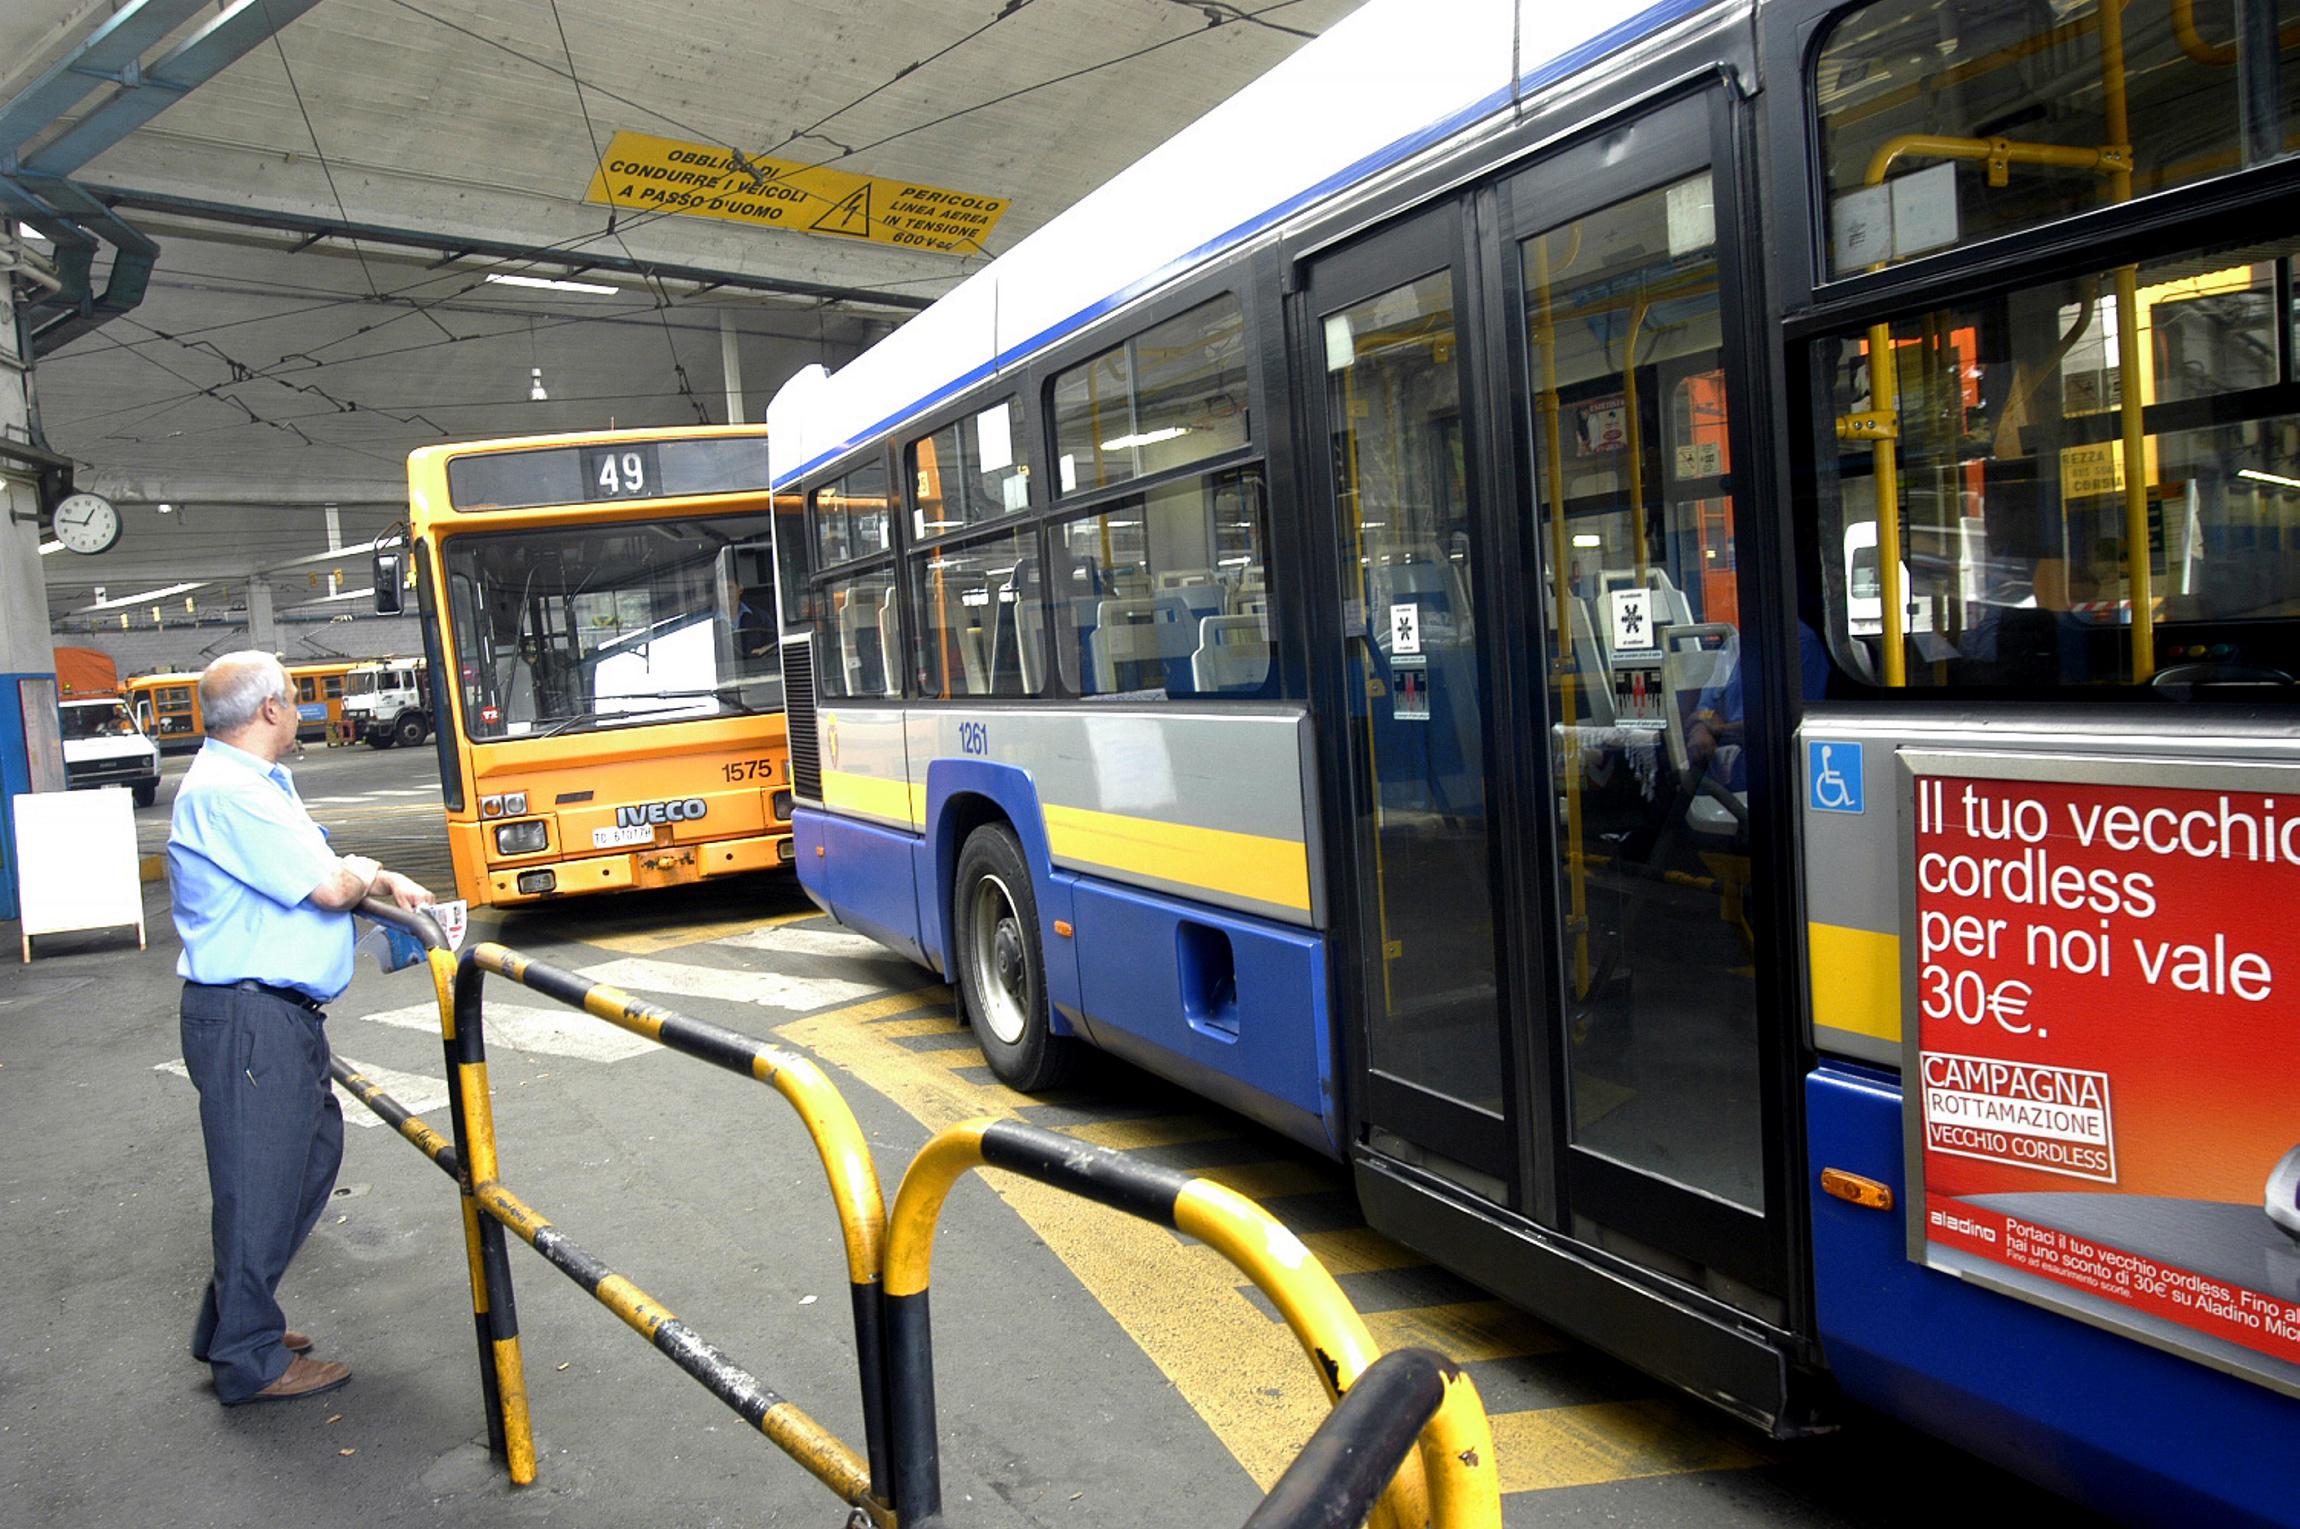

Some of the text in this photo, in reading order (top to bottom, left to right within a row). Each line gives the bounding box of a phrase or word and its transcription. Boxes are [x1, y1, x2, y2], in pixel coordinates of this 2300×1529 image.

[610, 160, 808, 203] CONDURRE I VEICOLI
[760, 166, 781, 178] DI
[618, 185, 783, 220] A PASSO D'UOMO
[889, 201, 989, 225] LINEA AEREA
[900, 187, 999, 211] PERICOLO
[882, 215, 980, 238] IN TENSIONE
[599, 452, 644, 492] 49
[959, 722, 988, 755] 1261
[722, 759, 773, 782] 1575
[616, 799, 708, 828] IVECO
[1920, 779, 1943, 834] Il
[1961, 784, 2049, 842] tuo
[1918, 848, 2156, 918] cordless
[1921, 910, 2272, 1001] per noi vale
[1921, 964, 2048, 1038] 30€.
[1924, 1056, 2104, 1109] CAMPAGNA
[1932, 1093, 2100, 1137] ROTTAMAZIONE
[1930, 1124, 2108, 1171] VECCHIO CORDLESS
[1930, 1211, 1996, 1243] aladino
[2006, 1217, 2055, 1246] Portaci
[2058, 1233, 2067, 1249] il
[2070, 1239, 2094, 1257] tuo
[2098, 1249, 2157, 1278] vecchio
[2240, 1290, 2280, 1317] Fino
[2006, 1249, 2026, 1263] Fino
[2027, 1258, 2040, 1268] ad
[2041, 1262, 2099, 1287] esaurimento
[2006, 1233, 2028, 1252] hai
[2032, 1246, 2059, 1262] uno
[2062, 1253, 2112, 1279] sconto
[2115, 1268, 2130, 1286] di
[2134, 1274, 2168, 1298] 30€
[2172, 1289, 2192, 1306] su
[2195, 1295, 2260, 1328] Aladino
